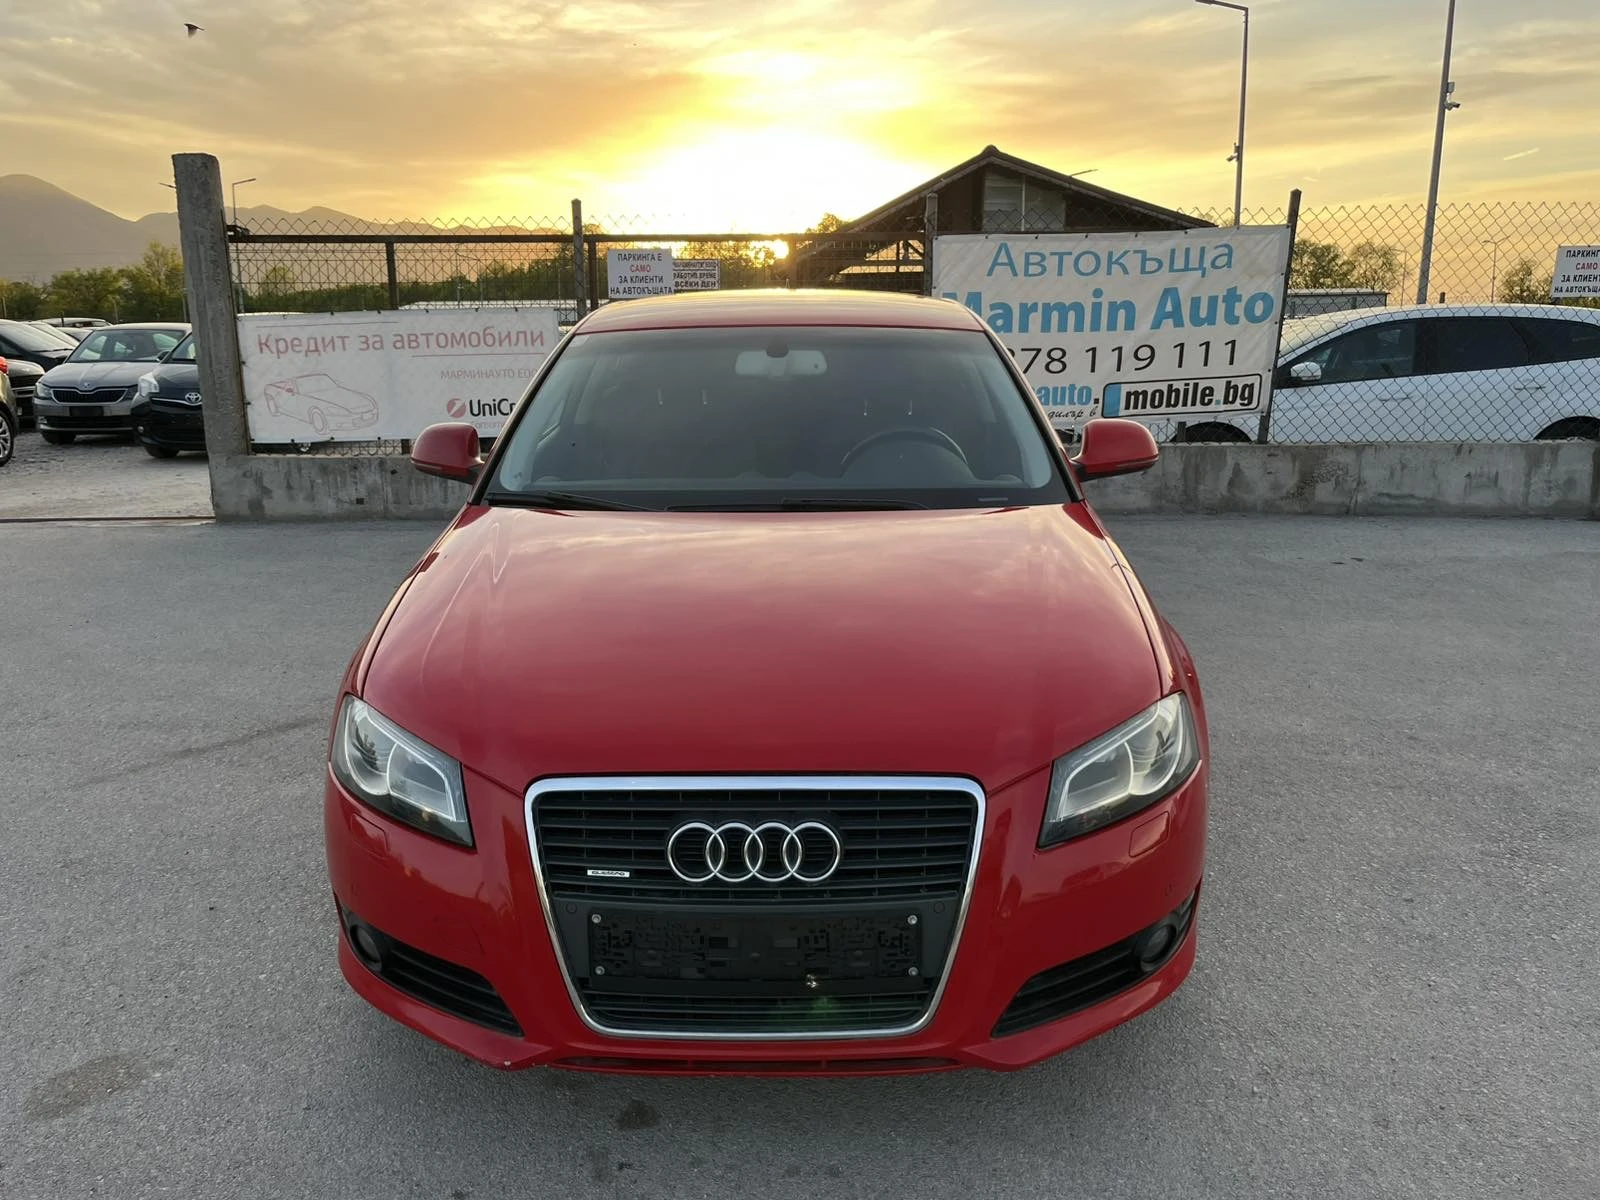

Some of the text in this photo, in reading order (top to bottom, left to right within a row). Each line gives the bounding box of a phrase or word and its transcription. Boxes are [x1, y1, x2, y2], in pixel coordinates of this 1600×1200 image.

[617, 253, 663, 261] ПАРКИНГА Е
[986, 242, 1234, 278] Автокъща
[630, 264, 651, 272] САМО
[618, 275, 664, 284] ЗА КЛИЕНТИ
[1561, 274, 1600, 282] ЗА КЛИЕН
[674, 280, 716, 288] ВСЕКИ ДЕН
[610, 286, 673, 295] НА АВТОКЪЩАТА
[1150, 286, 1274, 330] Auto
[257, 326, 545, 359] Кредит за автомобили
[1006, 339, 1237, 374] 78 119 111
[1124, 380, 1255, 411] mobile.bg
